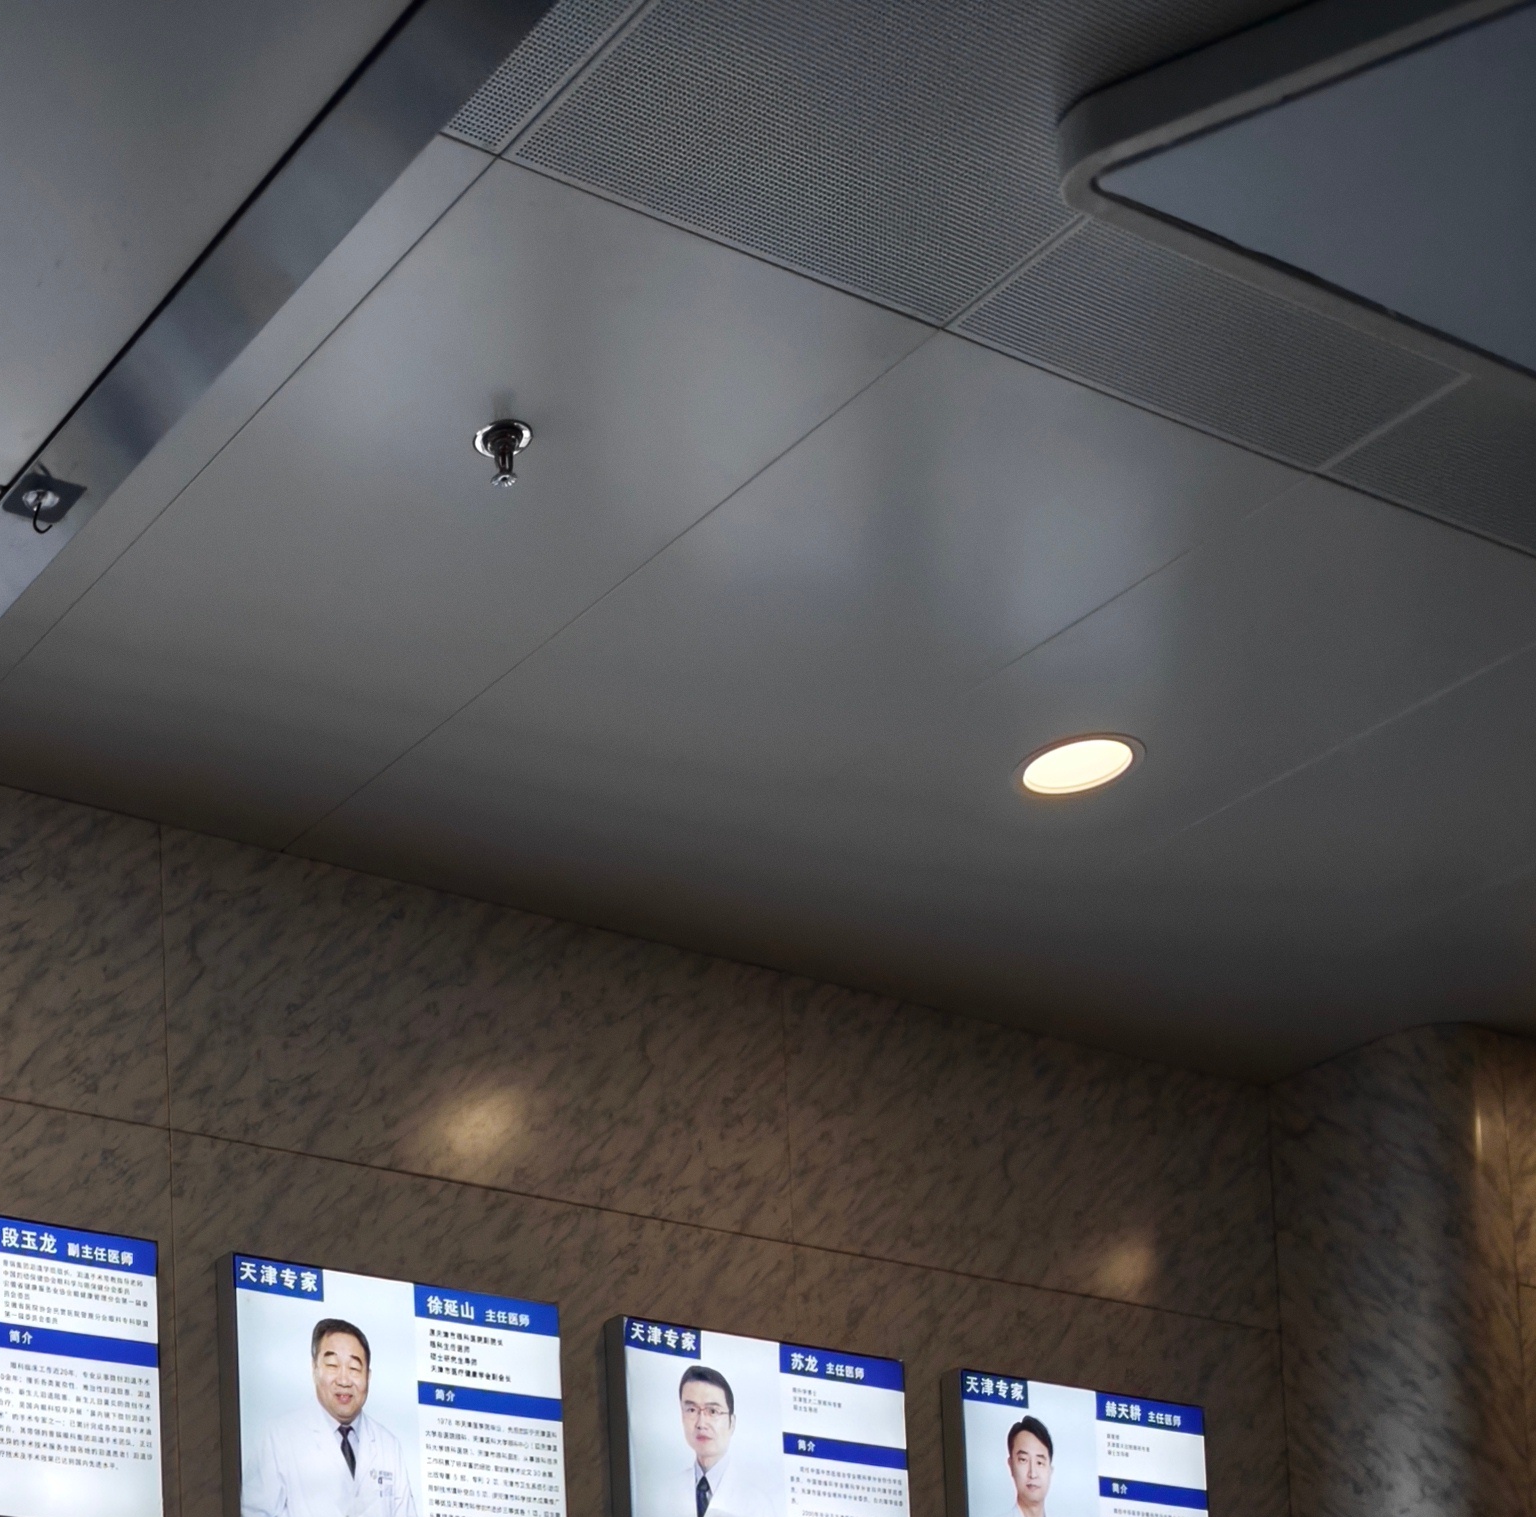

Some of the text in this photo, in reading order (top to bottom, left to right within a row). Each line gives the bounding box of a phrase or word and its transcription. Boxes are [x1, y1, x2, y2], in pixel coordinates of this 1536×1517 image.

[0, 1226, 134, 1267] 段玉龙 副主任医师
[240, 1263, 317, 1292] 天津专家
[426, 1294, 530, 1327] 徐延山 主任医师
[8, 1328, 33, 1345] 简介
[631, 1322, 697, 1351] 天津专家
[790, 1351, 865, 1380] 苏龙 主任医师
[434, 1387, 456, 1402] 简介
[966, 1376, 1024, 1401] 天津专家
[1147, 1410, 1181, 1427] 主任医师
[797, 1438, 816, 1452] 简介
[1111, 1481, 1128, 1494] 简介
